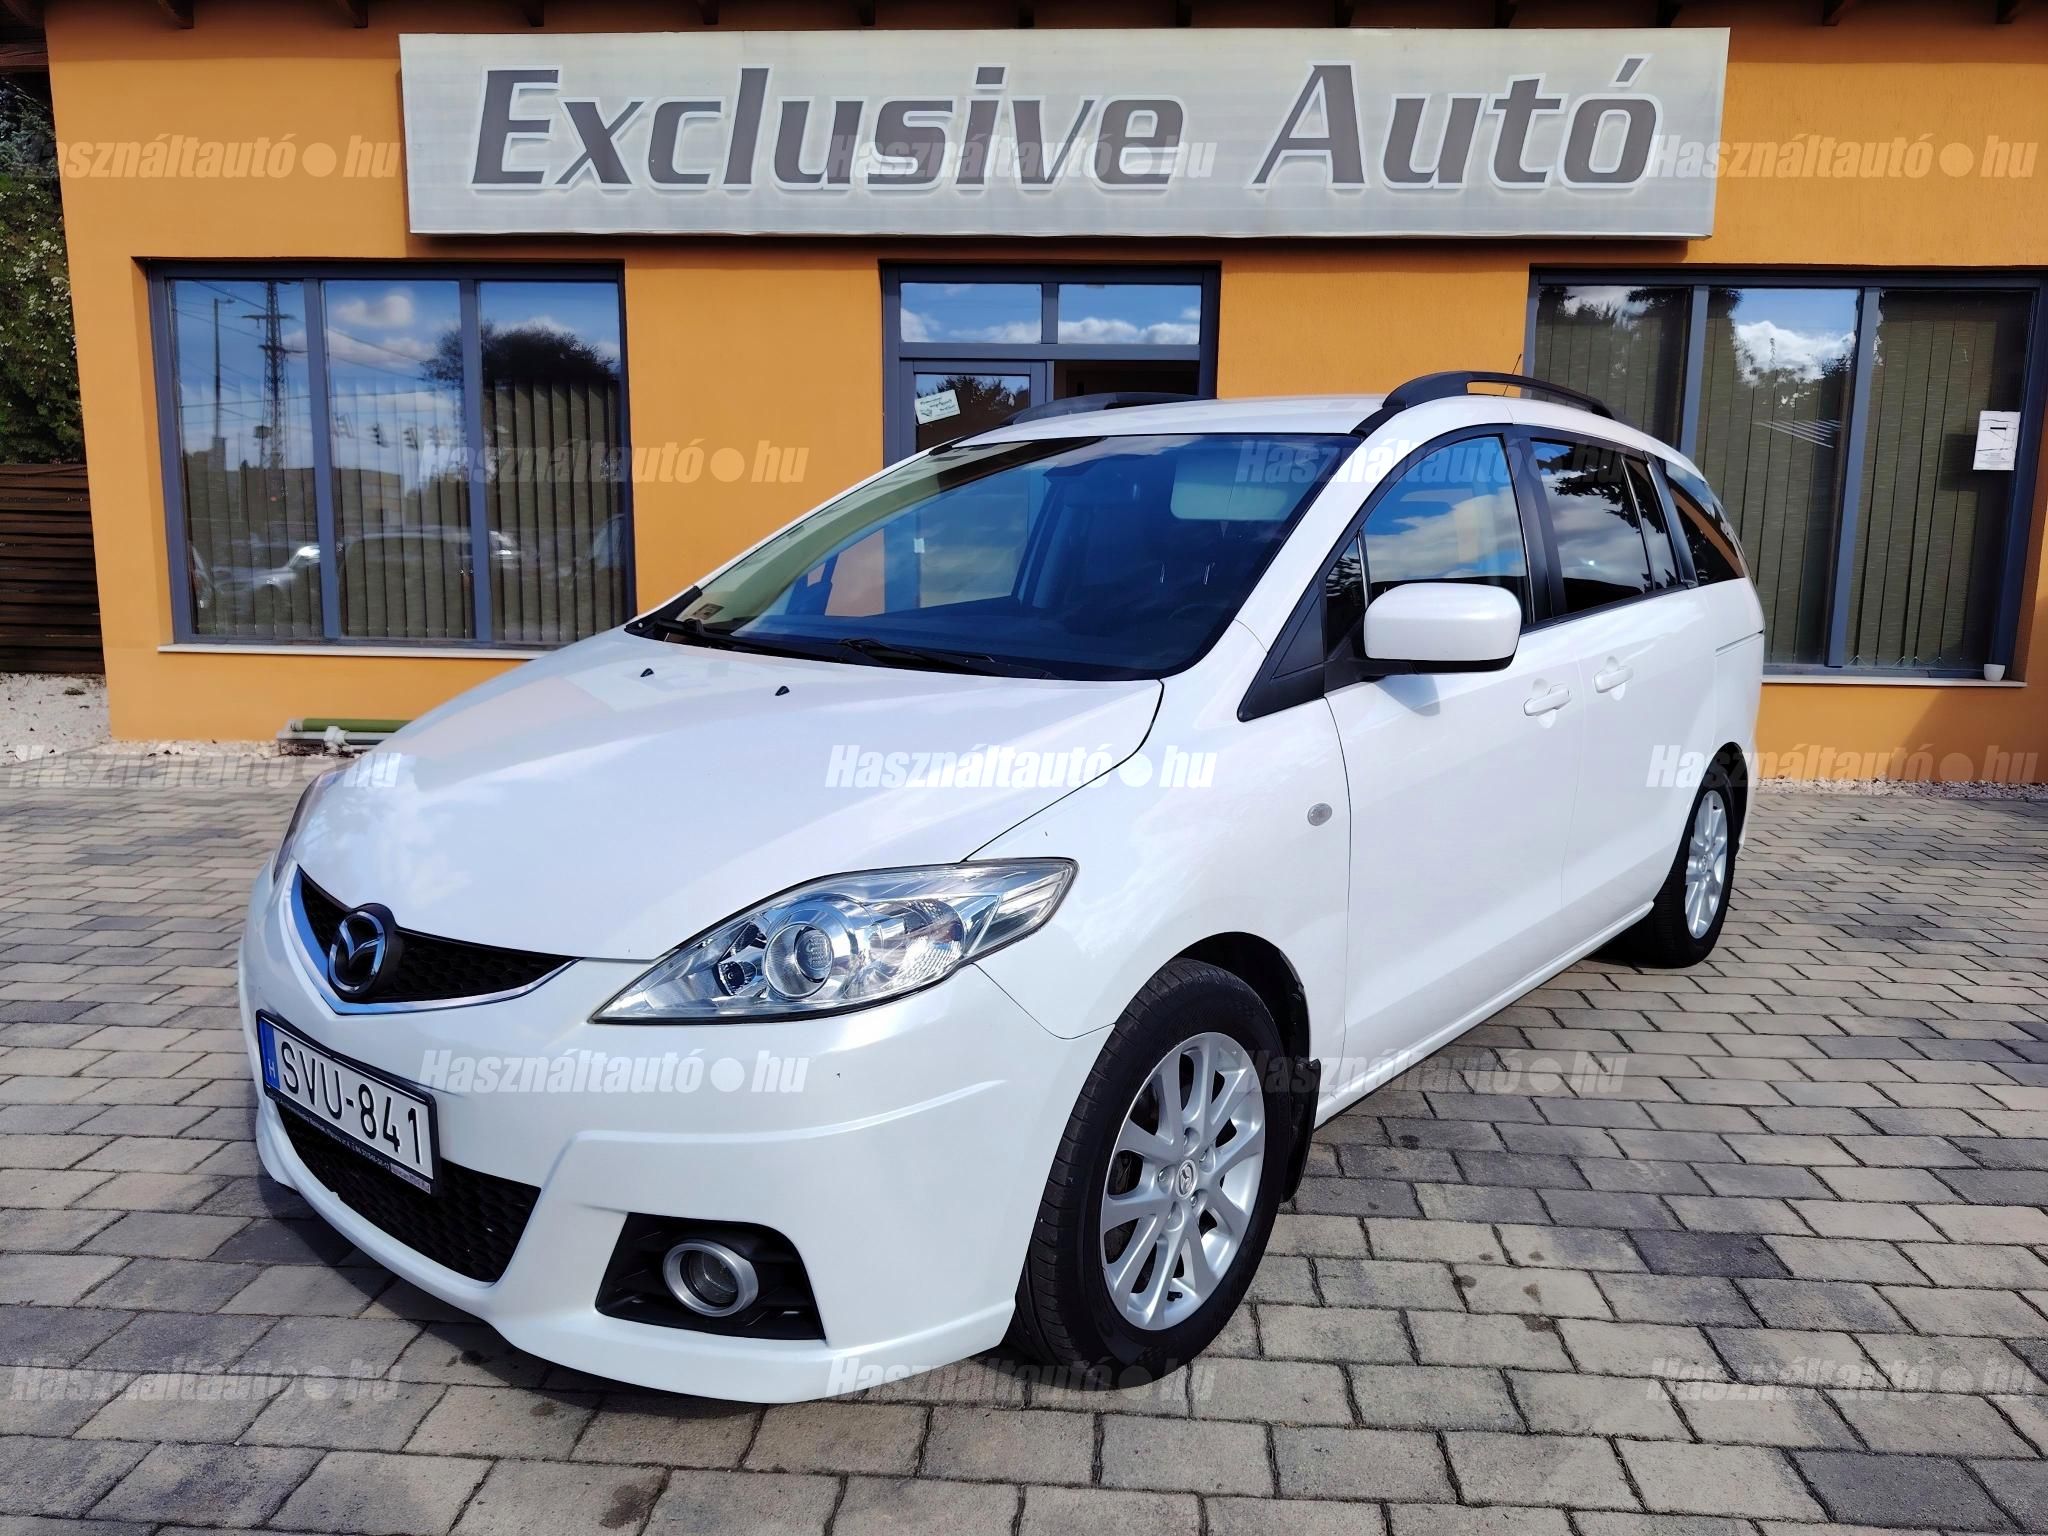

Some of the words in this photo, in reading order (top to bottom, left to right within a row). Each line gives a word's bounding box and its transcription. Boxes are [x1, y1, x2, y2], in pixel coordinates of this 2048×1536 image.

[469, 64, 1185, 192] Exclusive
[1246, 54, 1662, 191] Autó
[281, 1041, 422, 1165] SVU-841
